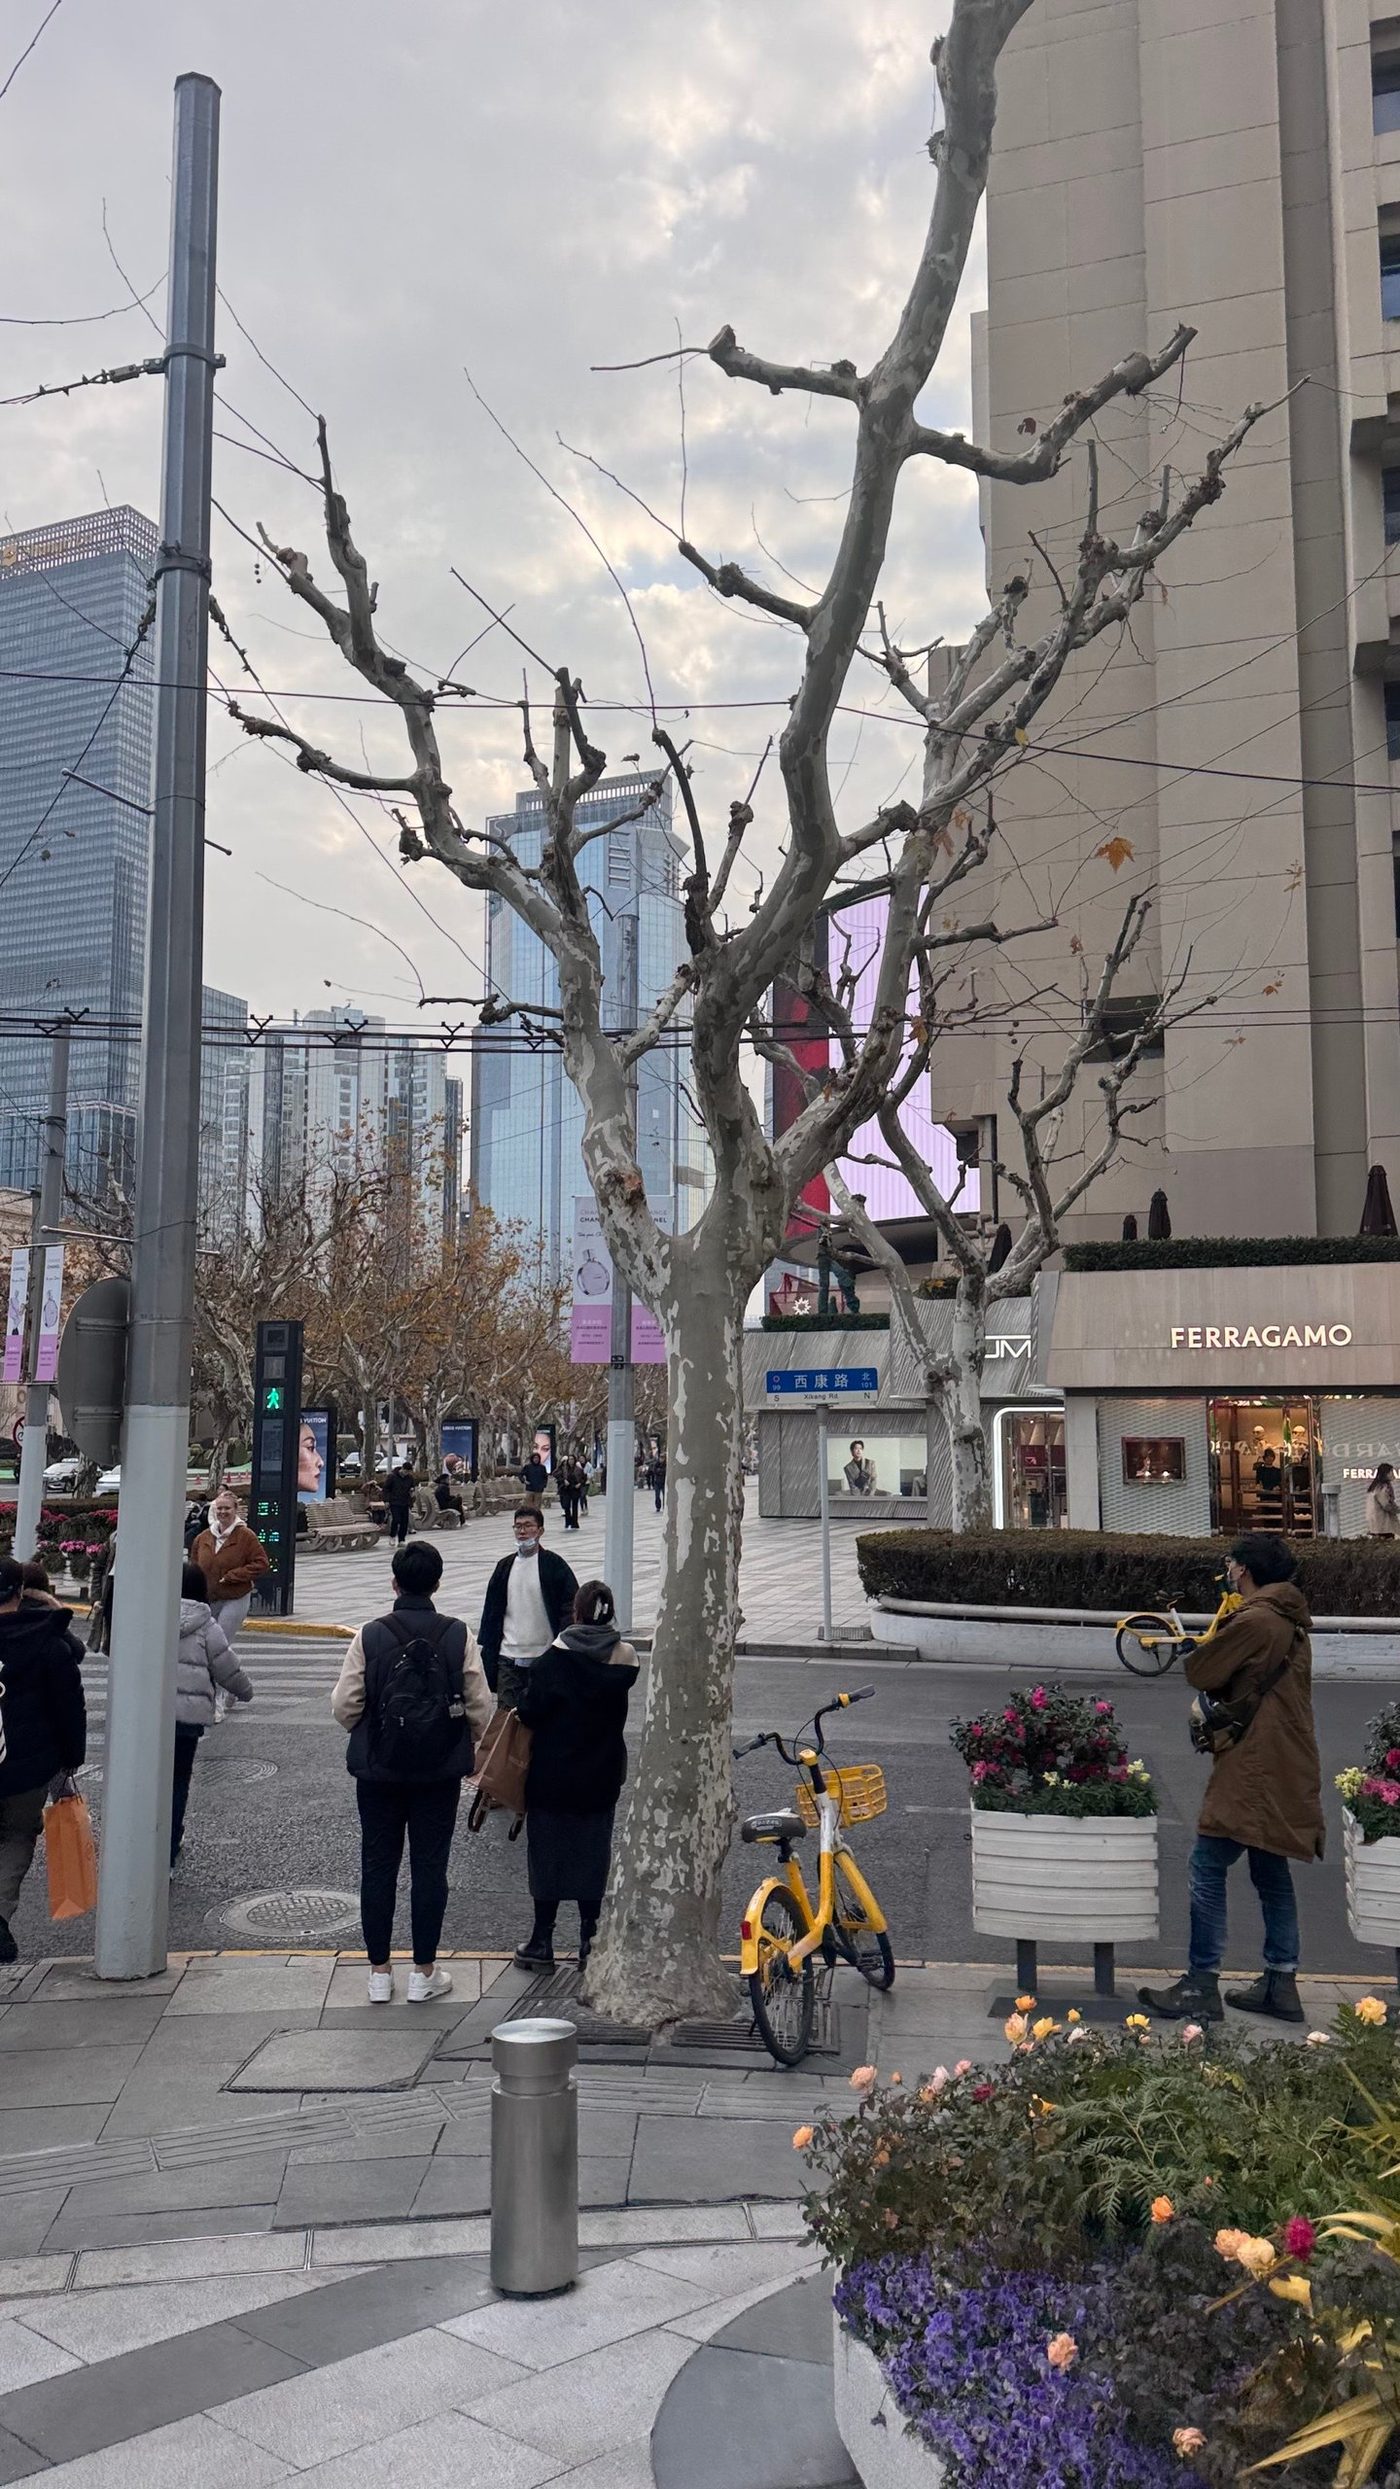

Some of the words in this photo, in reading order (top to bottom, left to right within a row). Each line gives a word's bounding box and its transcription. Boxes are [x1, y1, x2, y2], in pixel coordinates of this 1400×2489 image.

[1171, 1324, 1352, 1348] FERRAGAMO
[794, 1374, 848, 1389] 西康路
[774, 1394, 780, 1402] S
